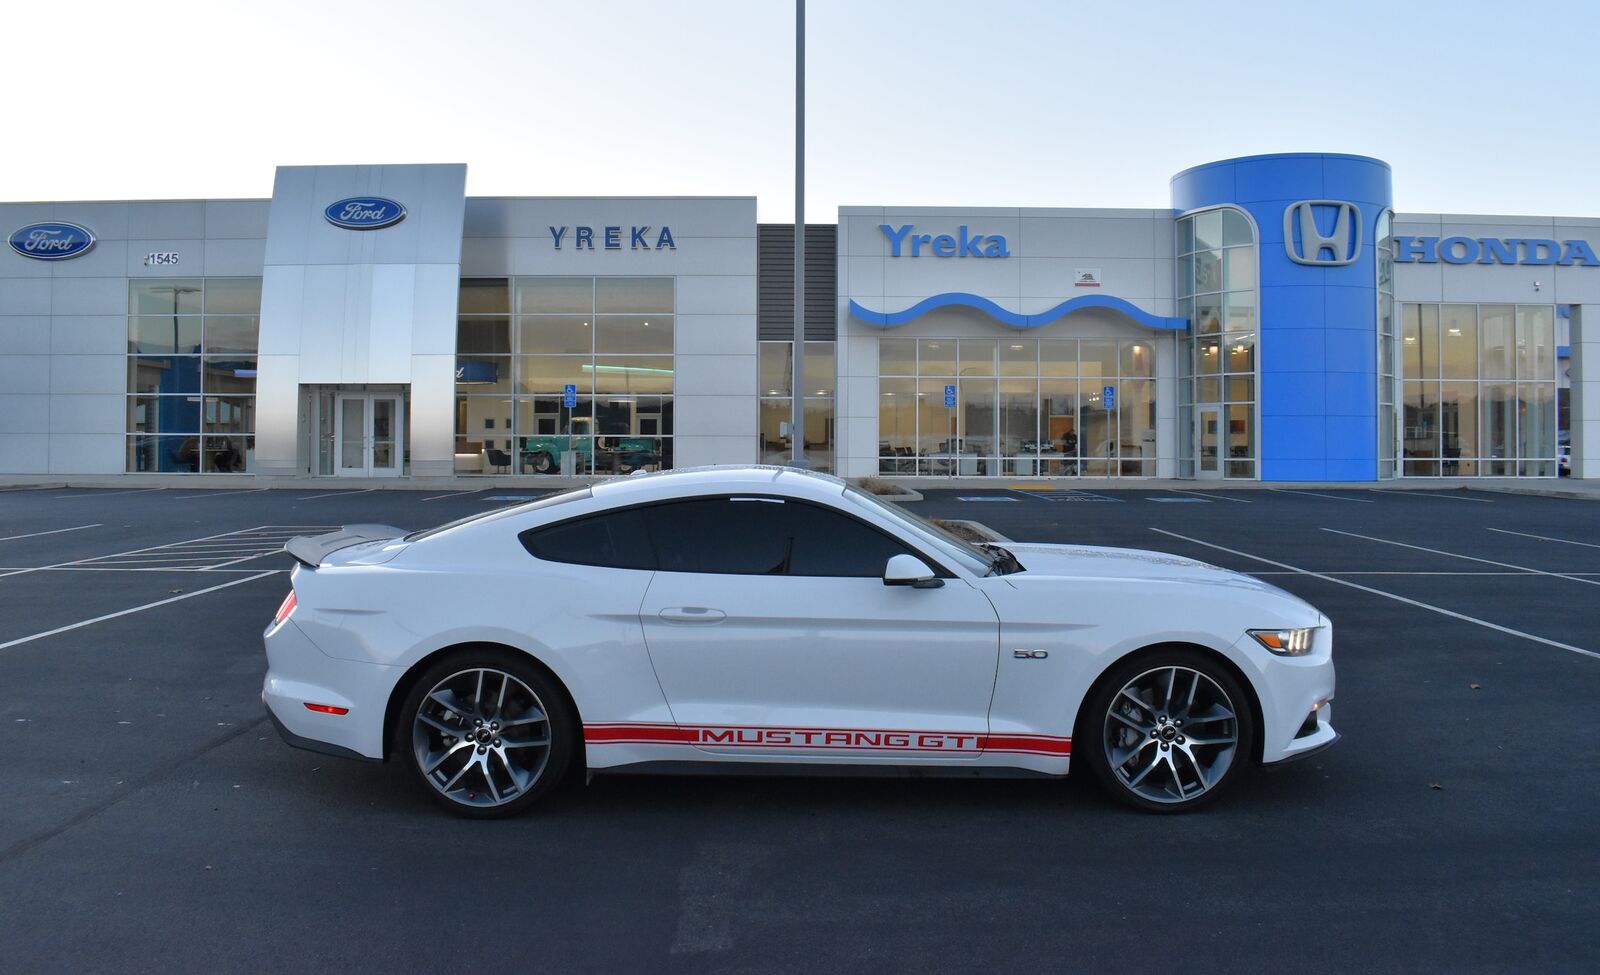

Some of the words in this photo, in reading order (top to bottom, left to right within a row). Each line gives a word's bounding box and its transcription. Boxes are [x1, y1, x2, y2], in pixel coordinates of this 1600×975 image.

[339, 203, 386, 222] Ford
[24, 229, 75, 251] Ford
[549, 226, 676, 250] YREKA
[880, 225, 1010, 259] Yreka
[149, 253, 179, 265] 1545
[1394, 236, 1600, 267] HONDA
[701, 728, 911, 749] MUSTANG
[917, 734, 975, 749] GT
